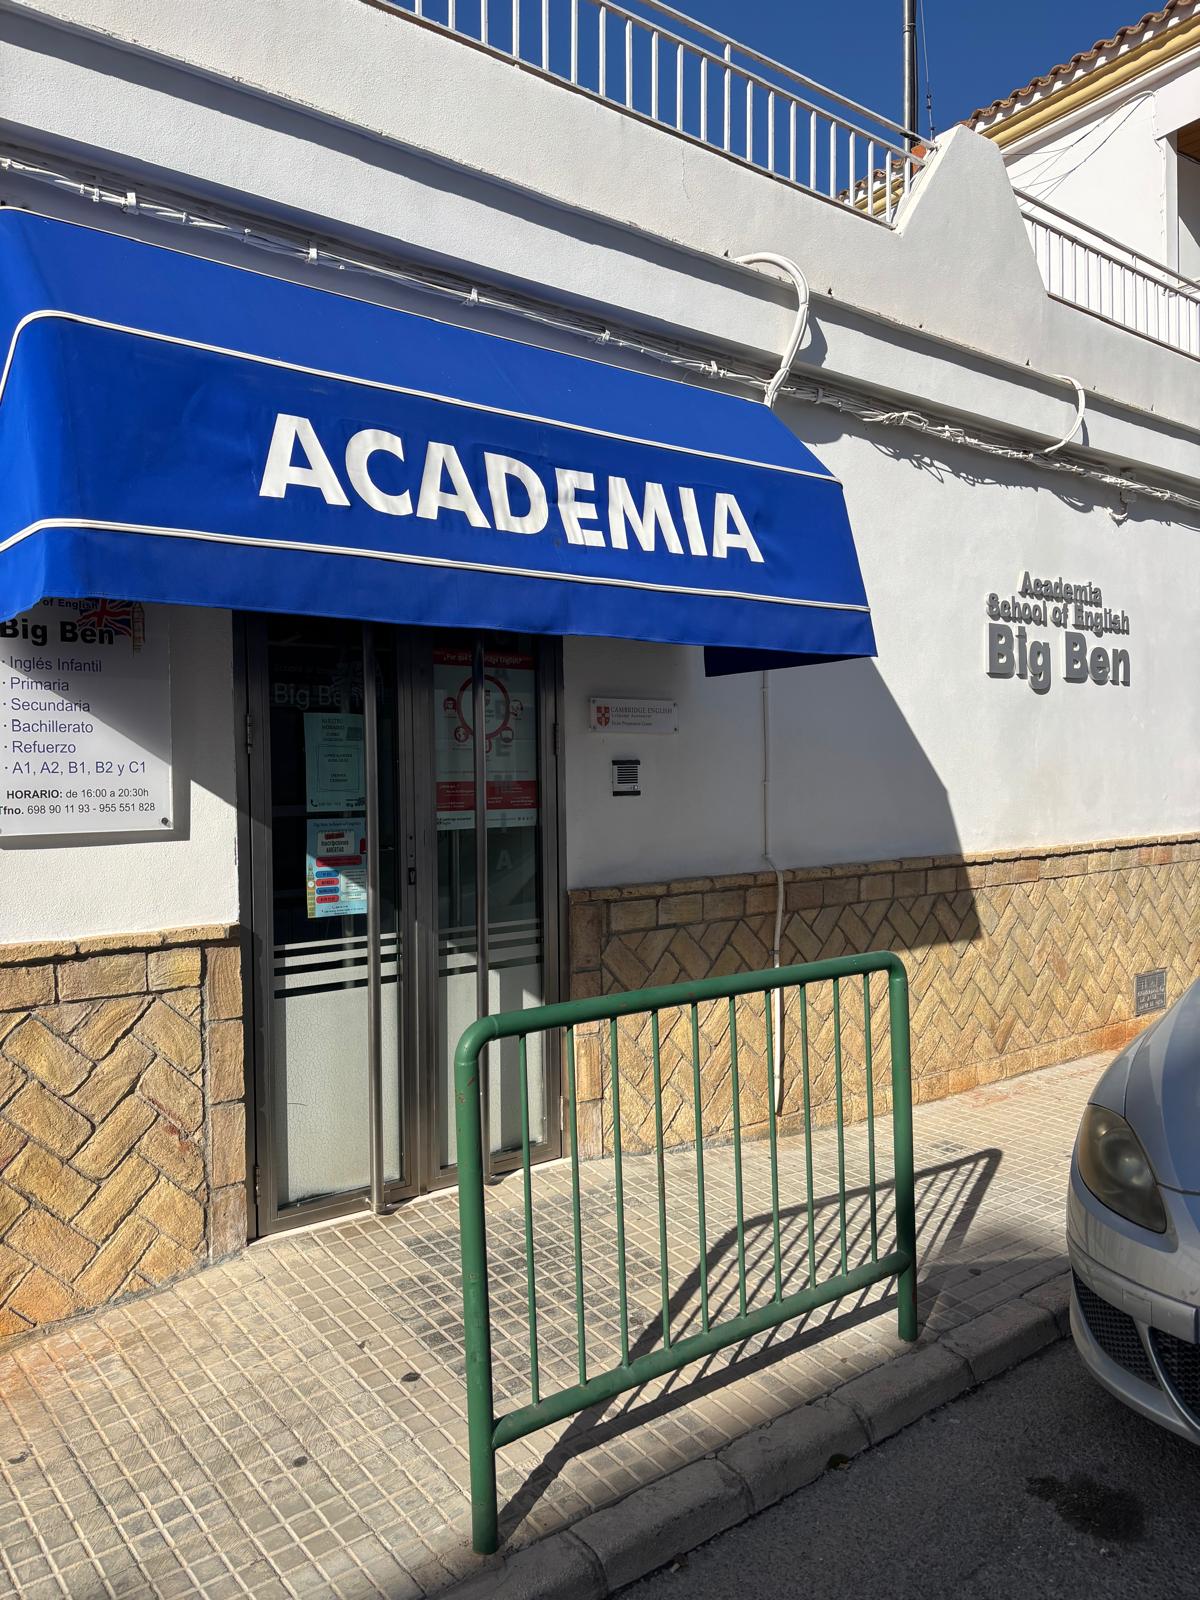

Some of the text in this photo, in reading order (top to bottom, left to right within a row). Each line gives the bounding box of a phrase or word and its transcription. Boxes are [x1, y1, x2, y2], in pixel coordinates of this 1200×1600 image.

[259, 412, 765, 563] ACADEMIA
[1018, 570, 1103, 608] Academia
[58, 599, 98, 610] English
[986, 592, 1130, 638] School of English
[0, 618, 114, 646] Big Ben
[10, 655, 102, 673] Inglés Infantil
[986, 623, 1131, 695] Big Ben
[10, 676, 70, 691] Primaria
[273, 682, 311, 711] Big
[11, 697, 90, 712] Secundaria
[11, 718, 94, 733] Bachillerato
[12, 740, 77, 753] Refuerzo
[12, 761, 146, 776] A1, A2, B1, B2 y C1
[6, 789, 62, 799] HORARIO:
[65, 789, 78, 798] de
[81, 789, 107, 798] 16:00
[118, 788, 149, 797] 20:30h
[27, 804, 46, 815] 698
[49, 804, 61, 814] 90
[65, 804, 74, 814] 11
[78, 804, 90, 813] 93
[99, 803, 116, 813] 955
[119, 803, 135, 812] 551
[138, 802, 155, 812] 828
